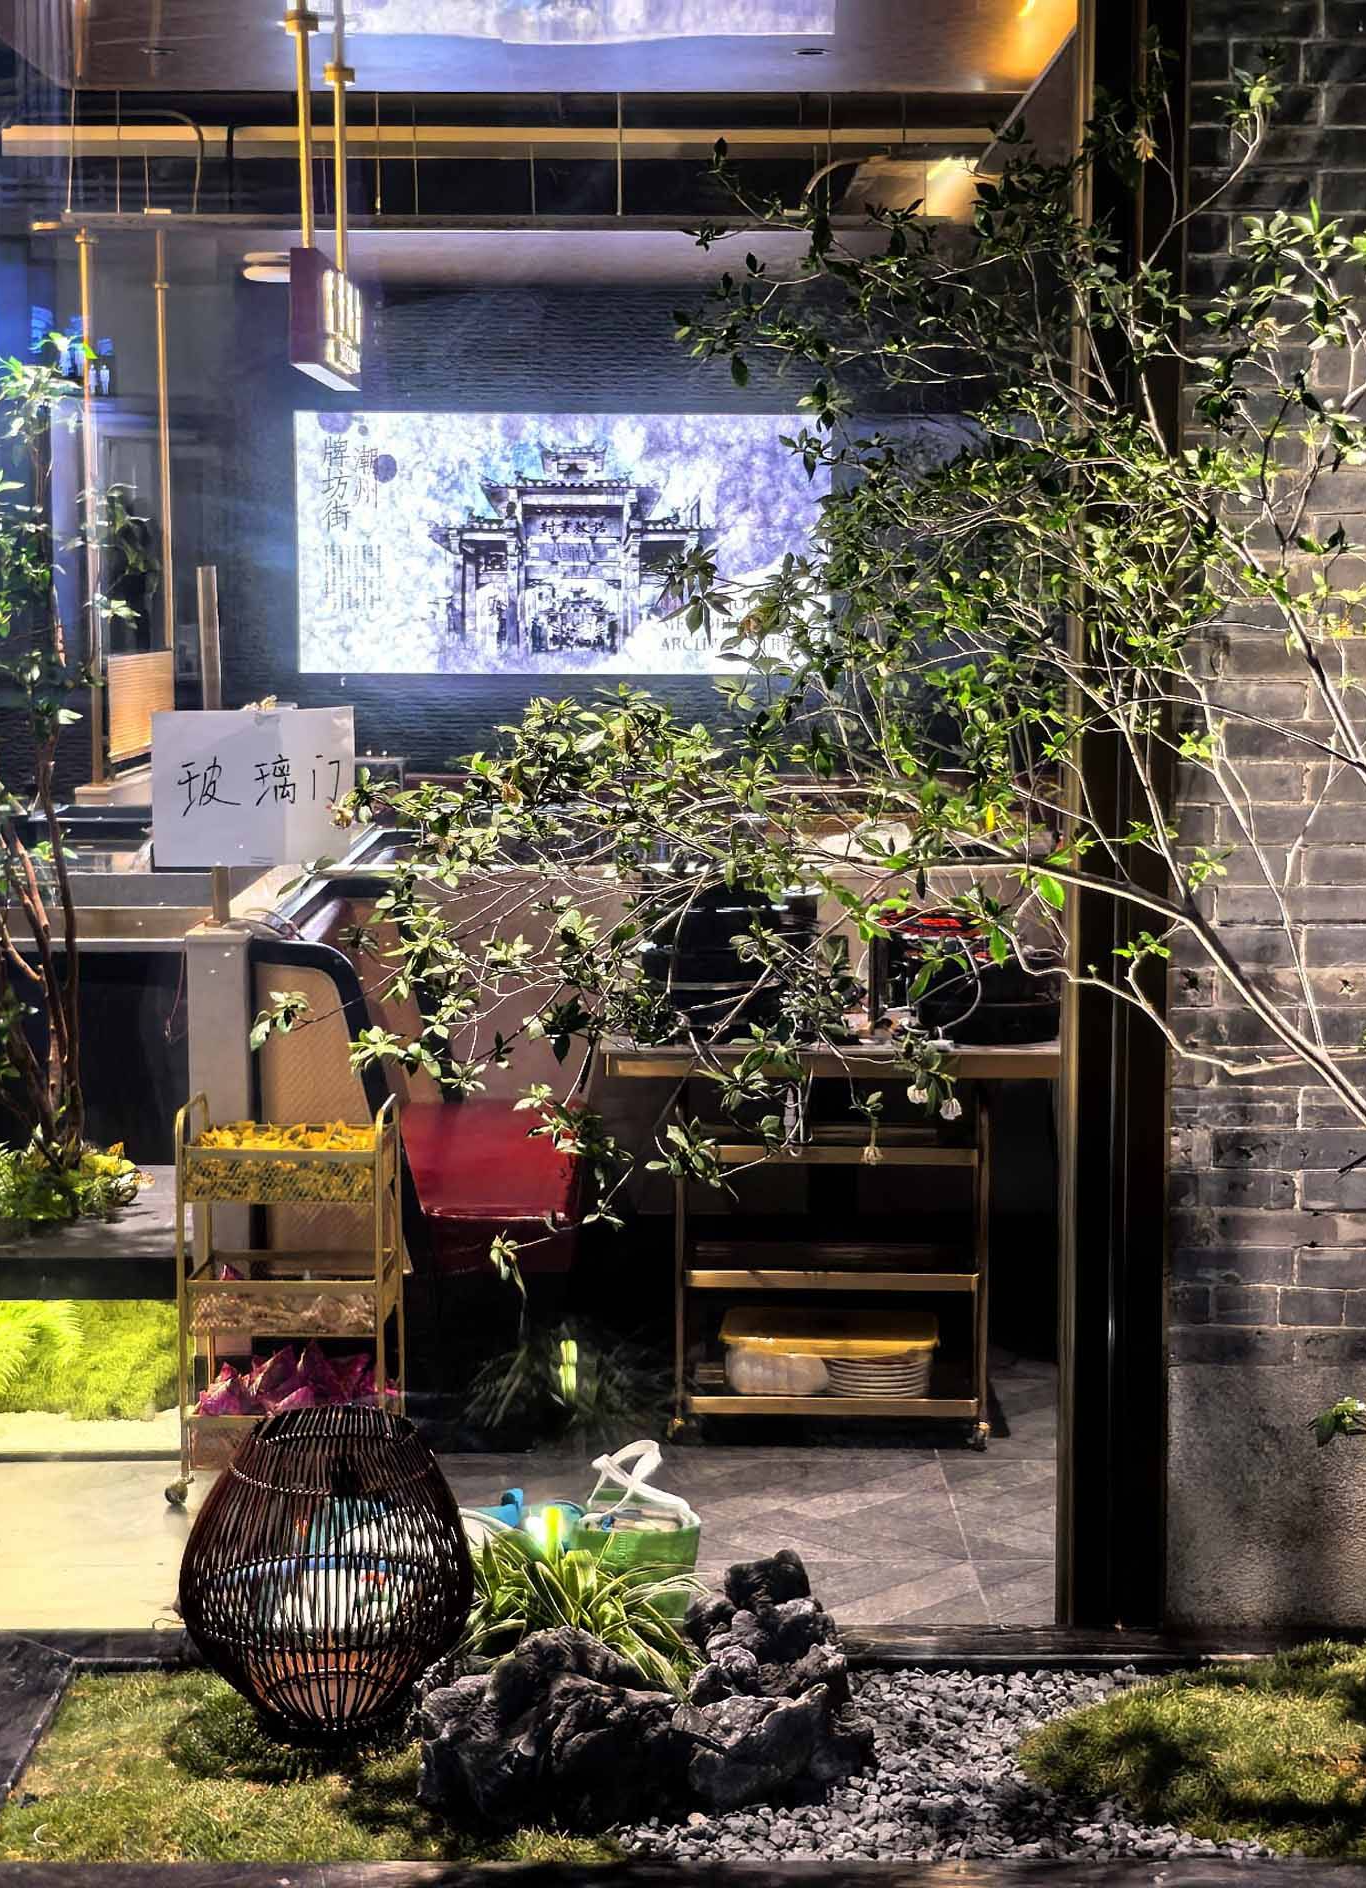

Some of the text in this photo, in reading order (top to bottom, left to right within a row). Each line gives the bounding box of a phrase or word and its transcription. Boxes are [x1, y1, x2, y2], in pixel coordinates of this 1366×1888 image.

[321, 435, 351, 533] 牌坊街
[353, 444, 378, 509] 潮州
[176, 754, 340, 817] 玻璃门
